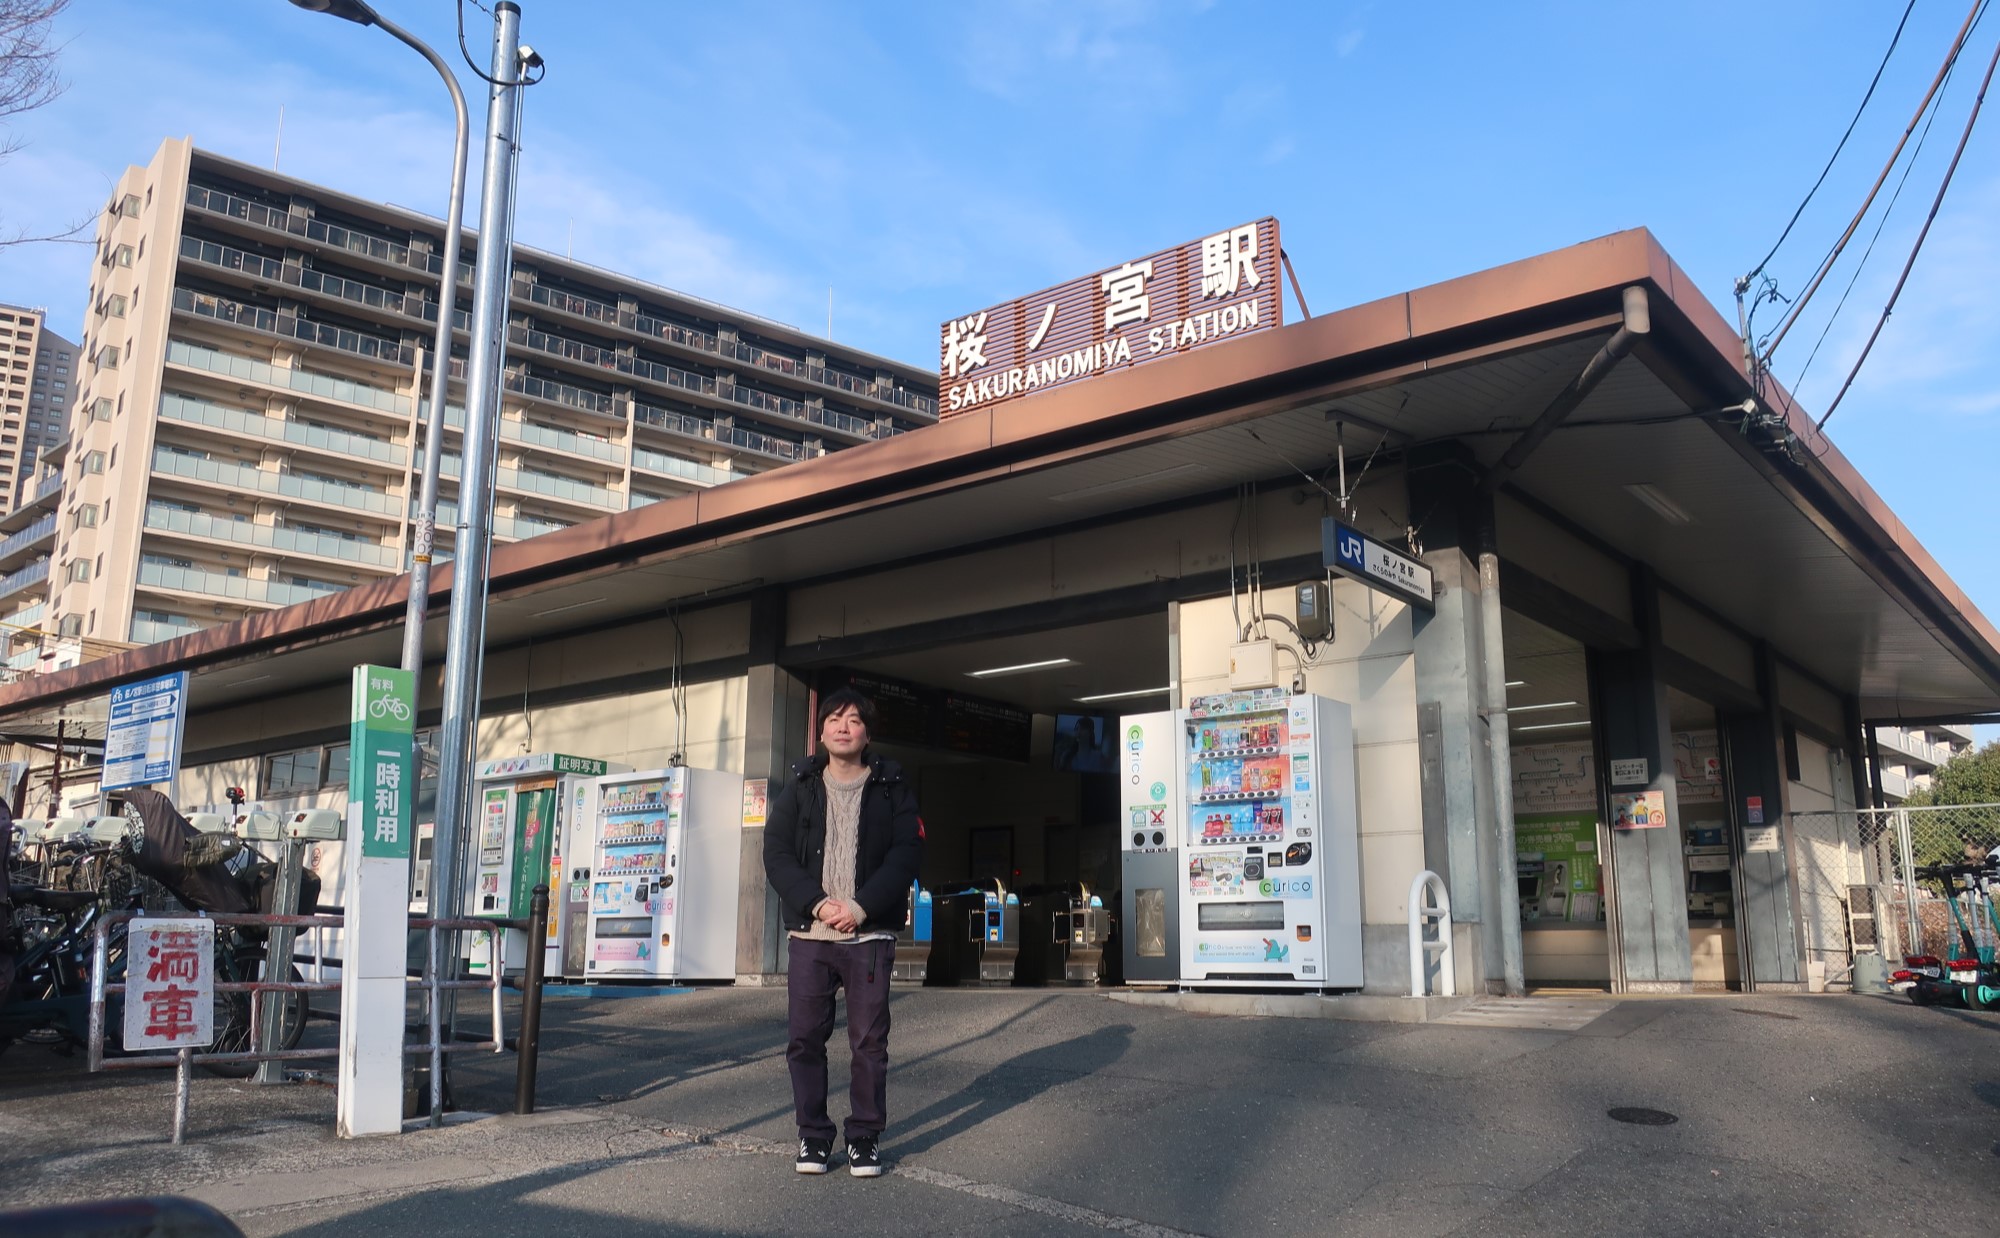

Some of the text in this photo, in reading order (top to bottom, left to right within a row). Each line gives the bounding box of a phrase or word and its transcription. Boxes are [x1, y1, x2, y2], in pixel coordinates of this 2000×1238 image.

[943, 223, 1261, 376] 桜ノ宮駅
[948, 298, 1259, 410] SAKURANOMIYA STATION
[1340, 537, 1362, 564] JR
[1382, 554, 1415, 579] 桜ノ宮駅
[370, 676, 394, 692] 有料
[558, 756, 602, 775] 証明写真
[374, 750, 401, 843] 一時利用
[1263, 880, 1311, 893] curico
[646, 898, 674, 911] curico
[143, 930, 199, 1041] 満車
